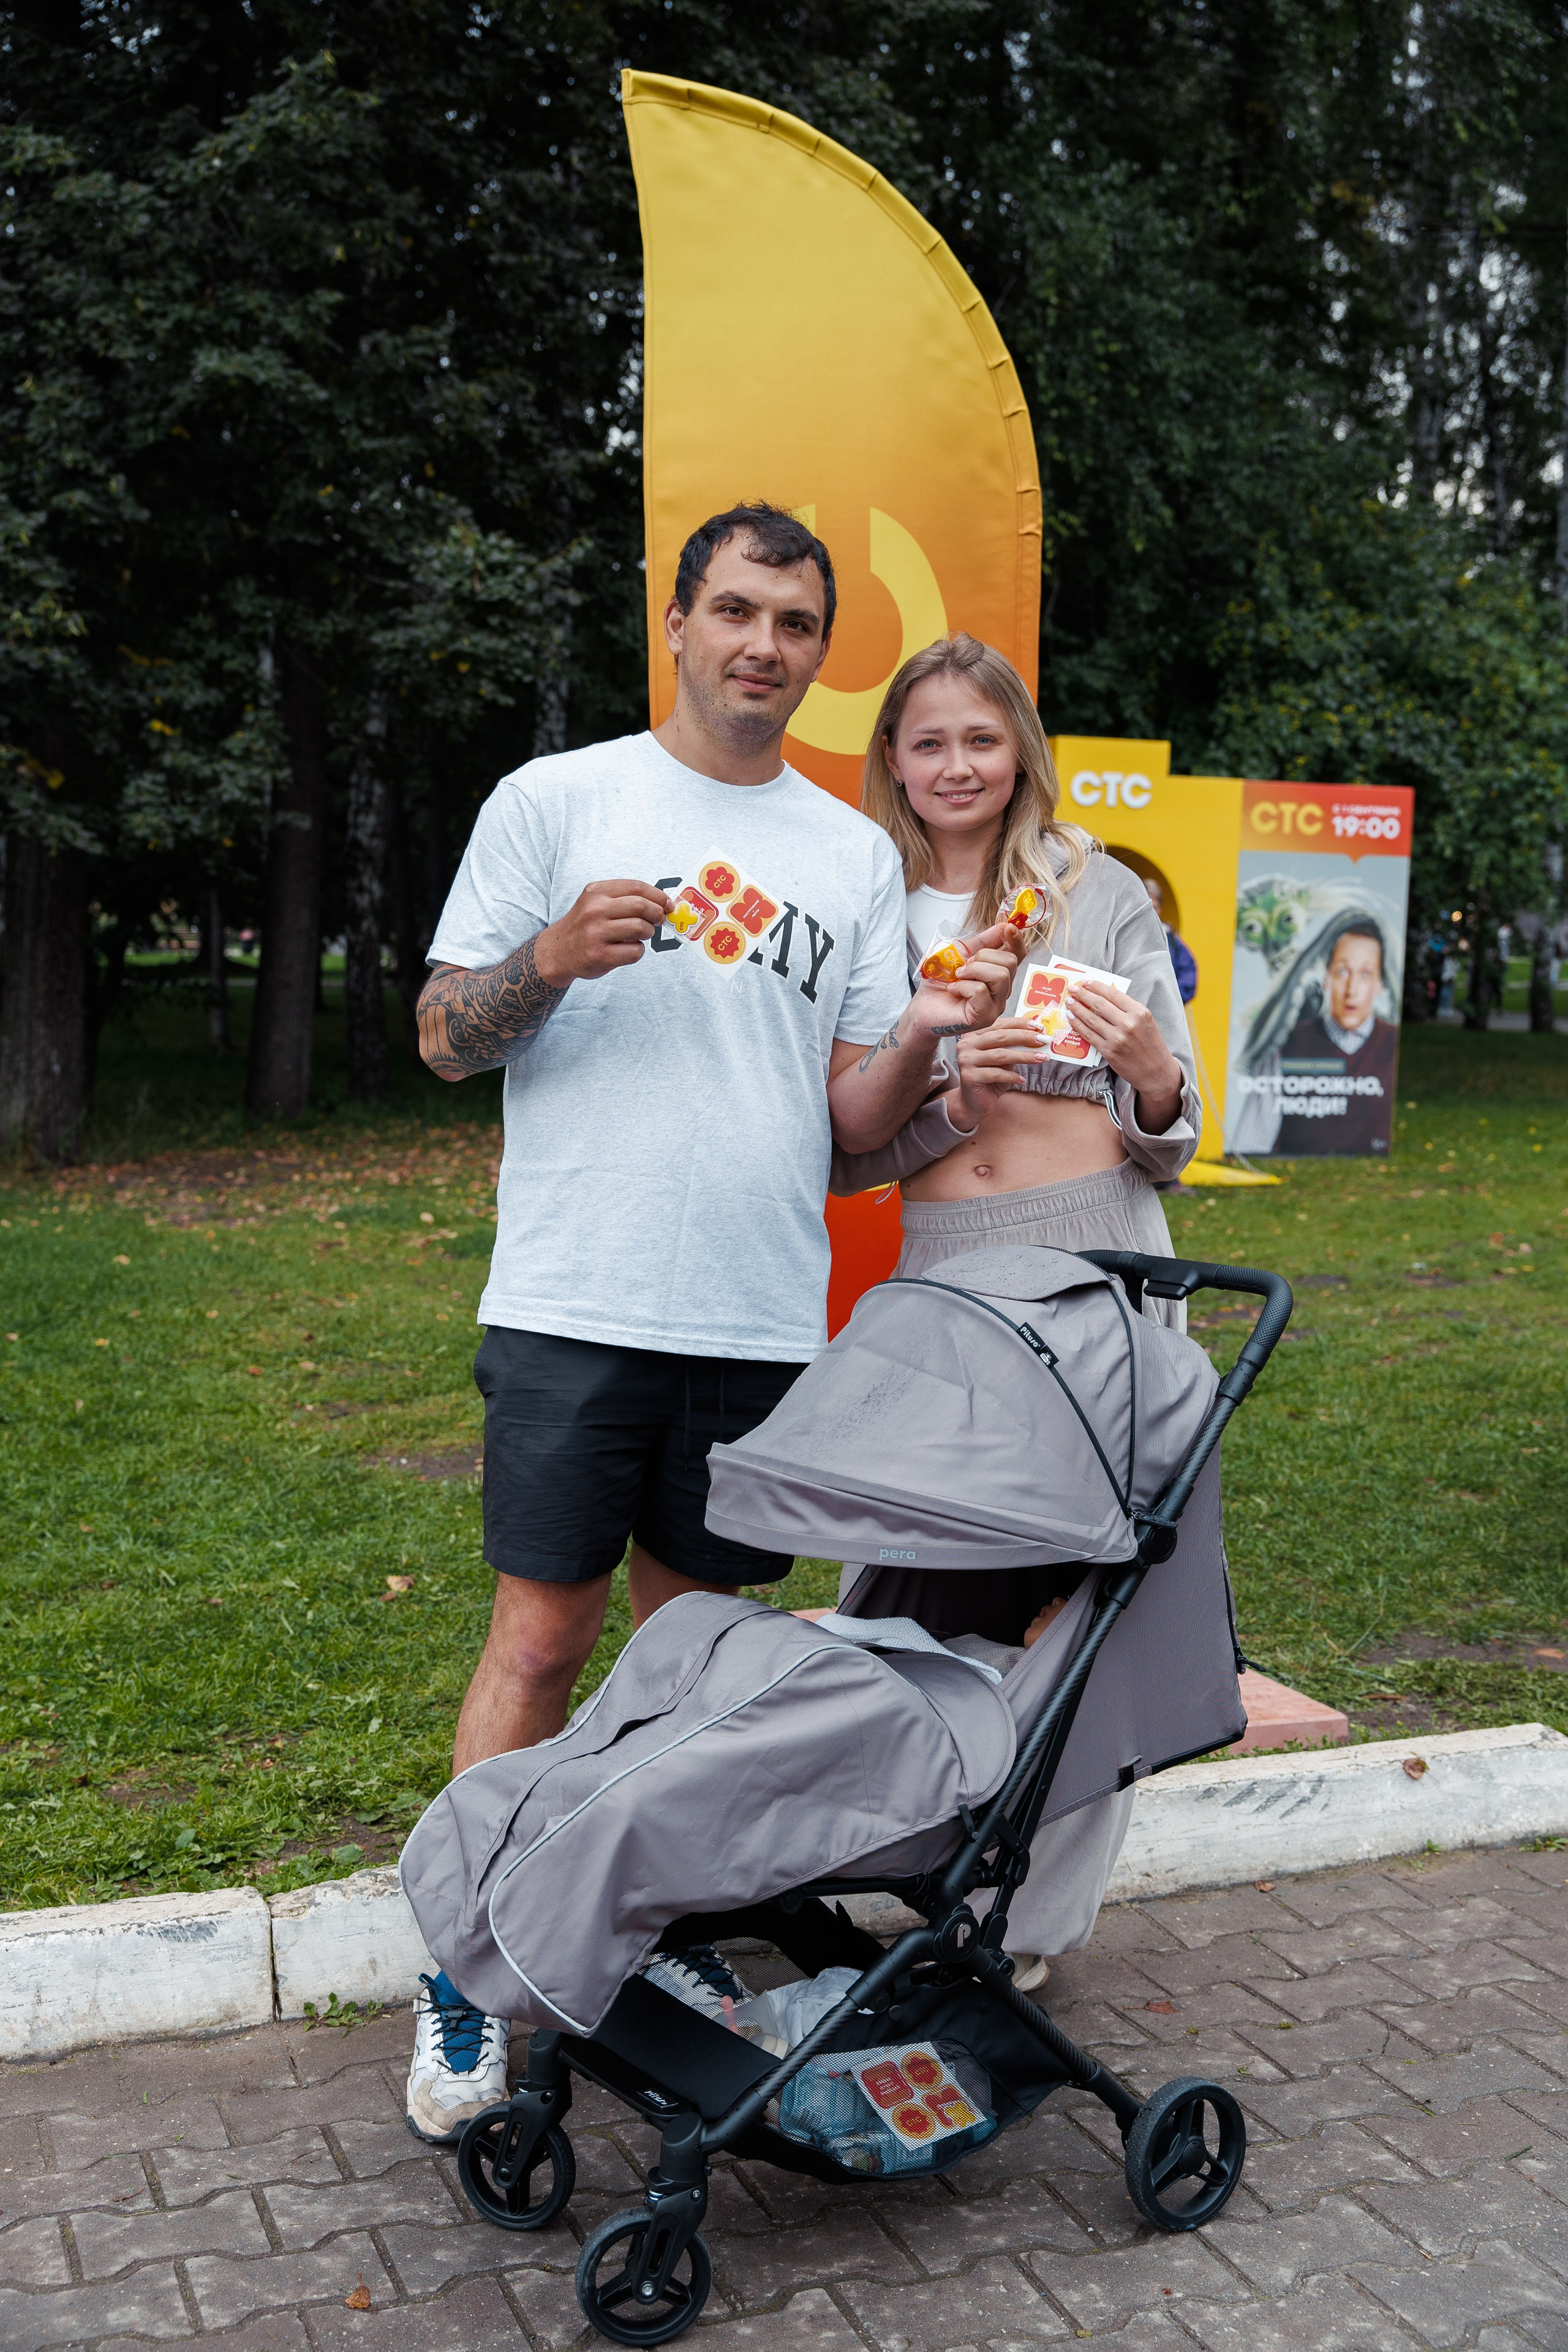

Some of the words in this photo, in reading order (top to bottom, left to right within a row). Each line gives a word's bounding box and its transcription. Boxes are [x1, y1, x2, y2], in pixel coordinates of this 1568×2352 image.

[1071, 771, 1152, 809] СТС
[1250, 801, 1324, 836] СТС
[1332, 815, 1401, 839] 19:00
[714, 875, 726, 888] СТС
[718, 935, 732, 951] СТС
[1238, 1076, 1384, 1098] ОСТОРОЖНО,
[1020, 1326, 1039, 1348] Pituso
[879, 1548, 916, 1561] pera
